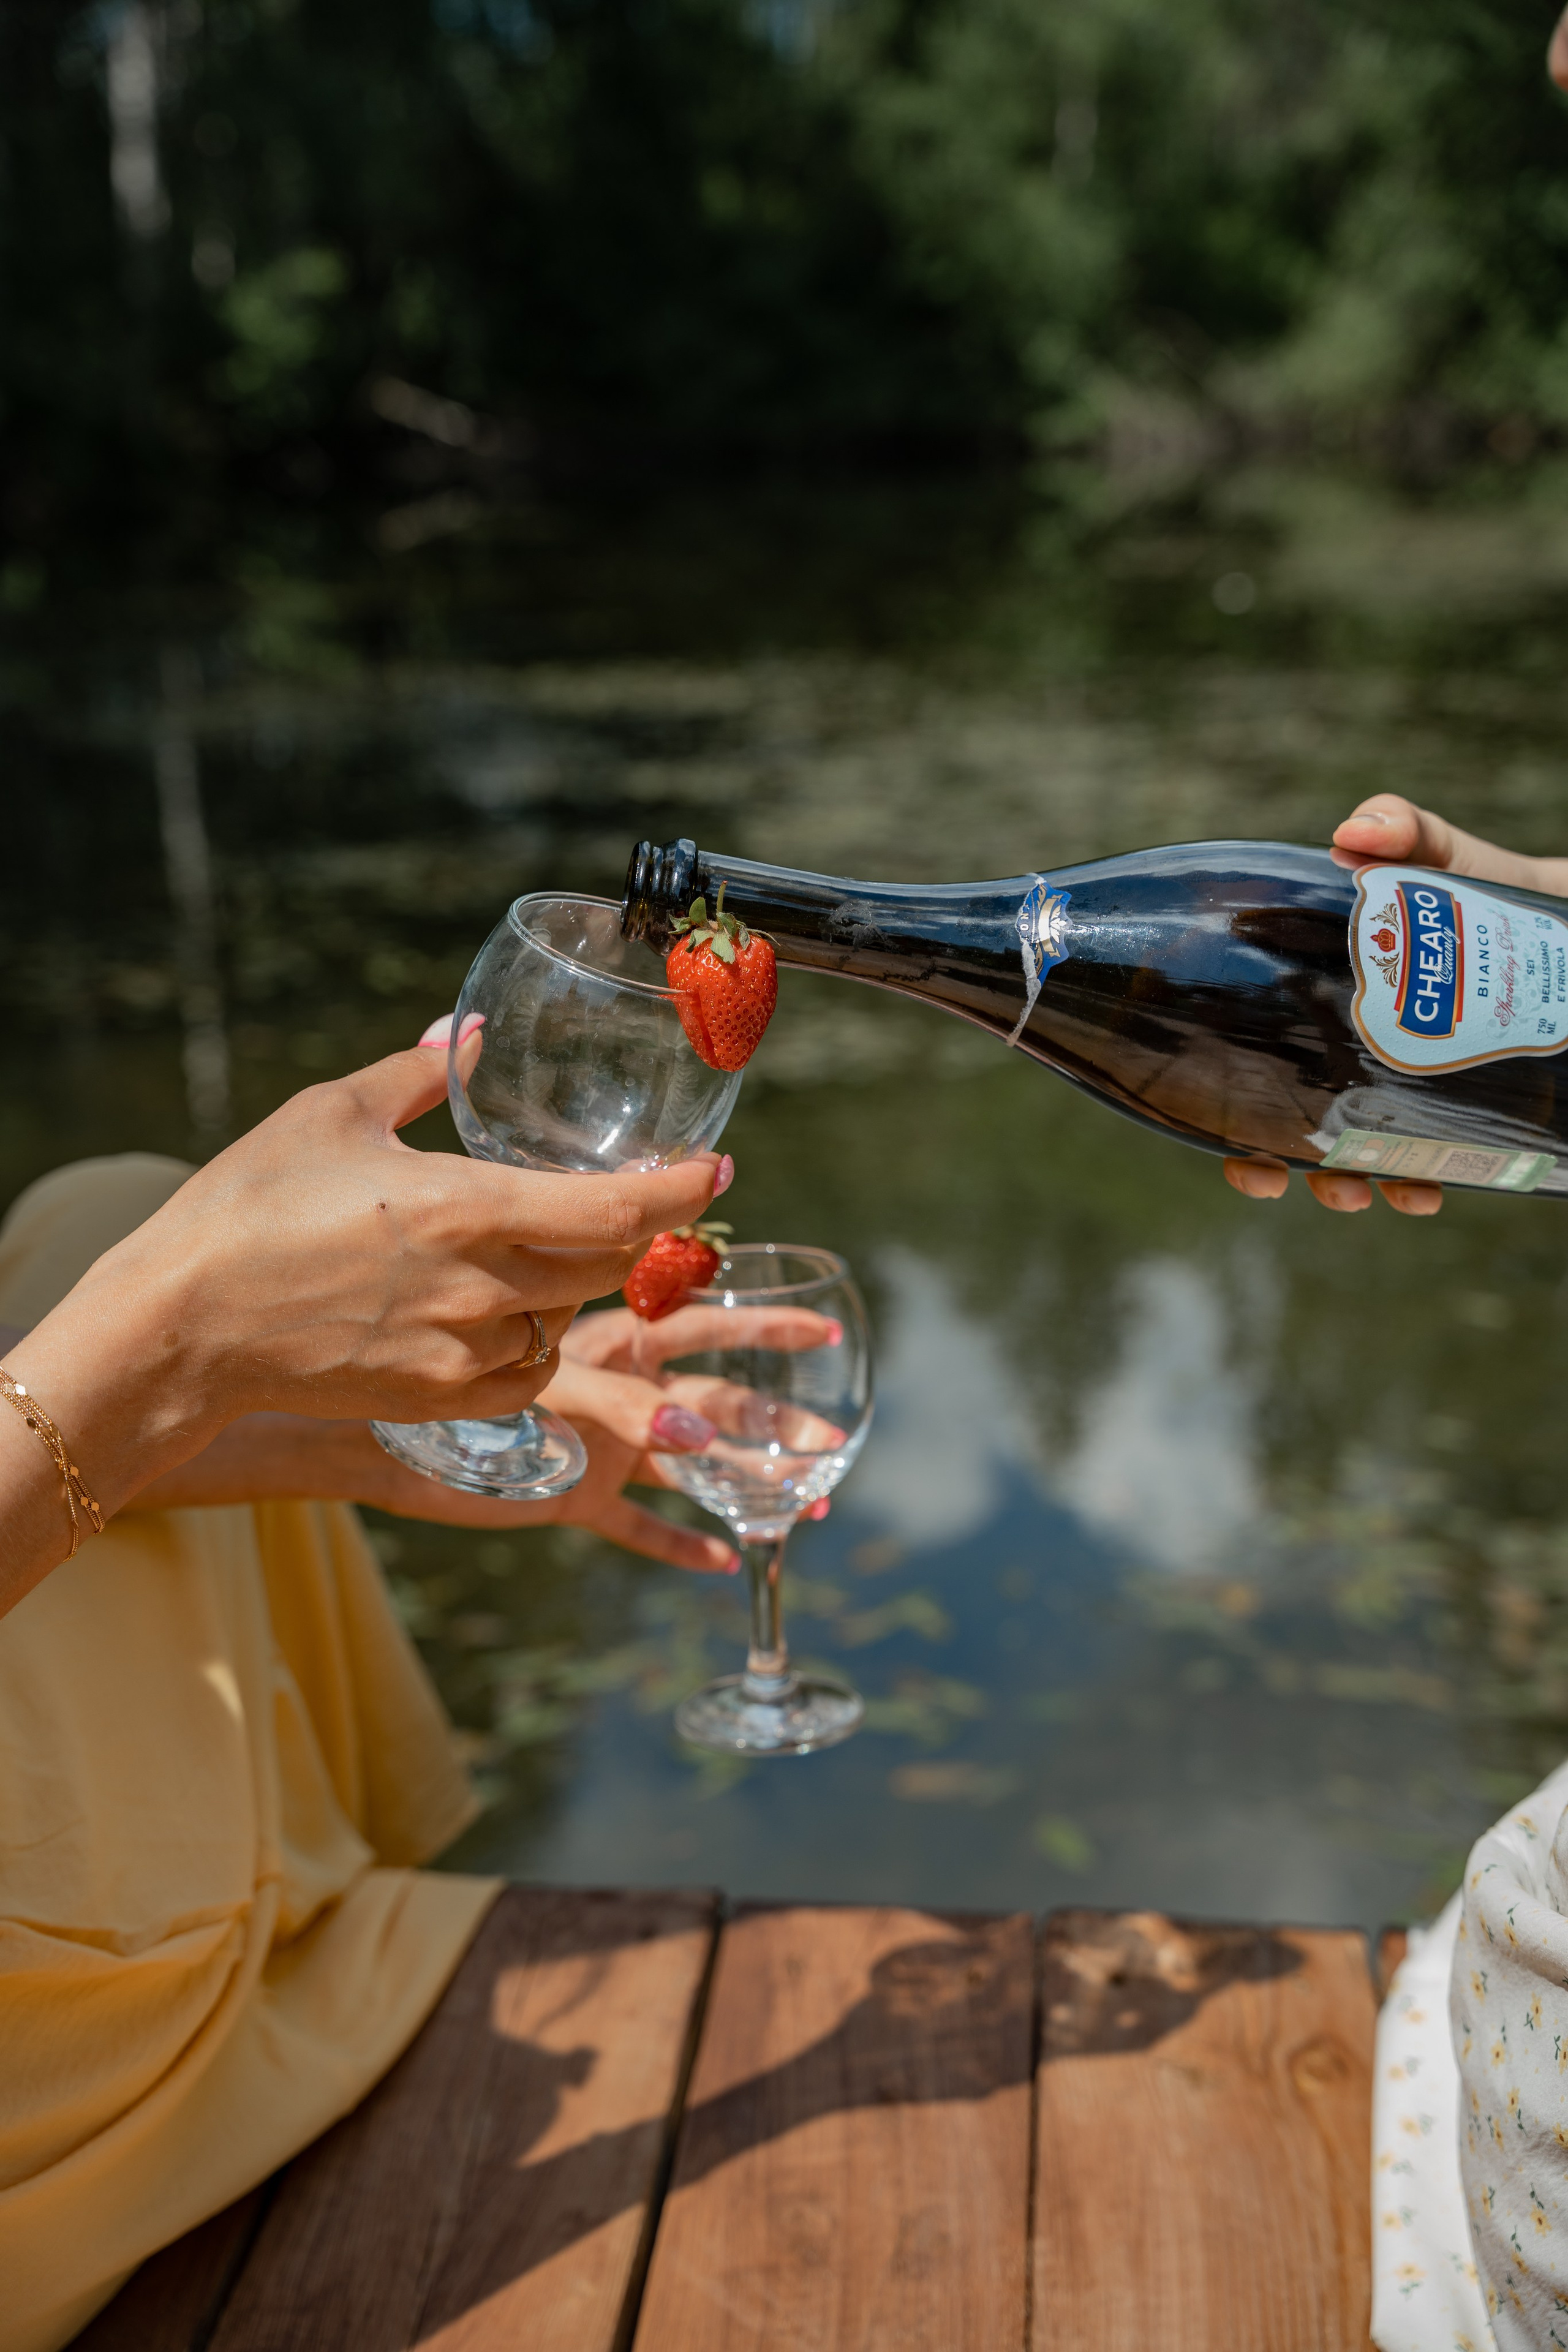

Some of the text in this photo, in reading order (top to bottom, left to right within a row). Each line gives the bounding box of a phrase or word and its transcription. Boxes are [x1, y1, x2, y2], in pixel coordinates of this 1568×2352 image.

[1414, 890, 1440, 1022] CHEARO
[1477, 925, 1488, 997] BIANCO
[1491, 912, 1521, 1027] Sparkling Drink
[1526, 959, 1535, 976] SEI
[1540, 941, 1550, 1004] BELLISSIMO
[1556, 947, 1566, 992] FRIVOLA
[1537, 1018, 1547, 1035] 750
[1547, 1021, 1556, 1035] ML
